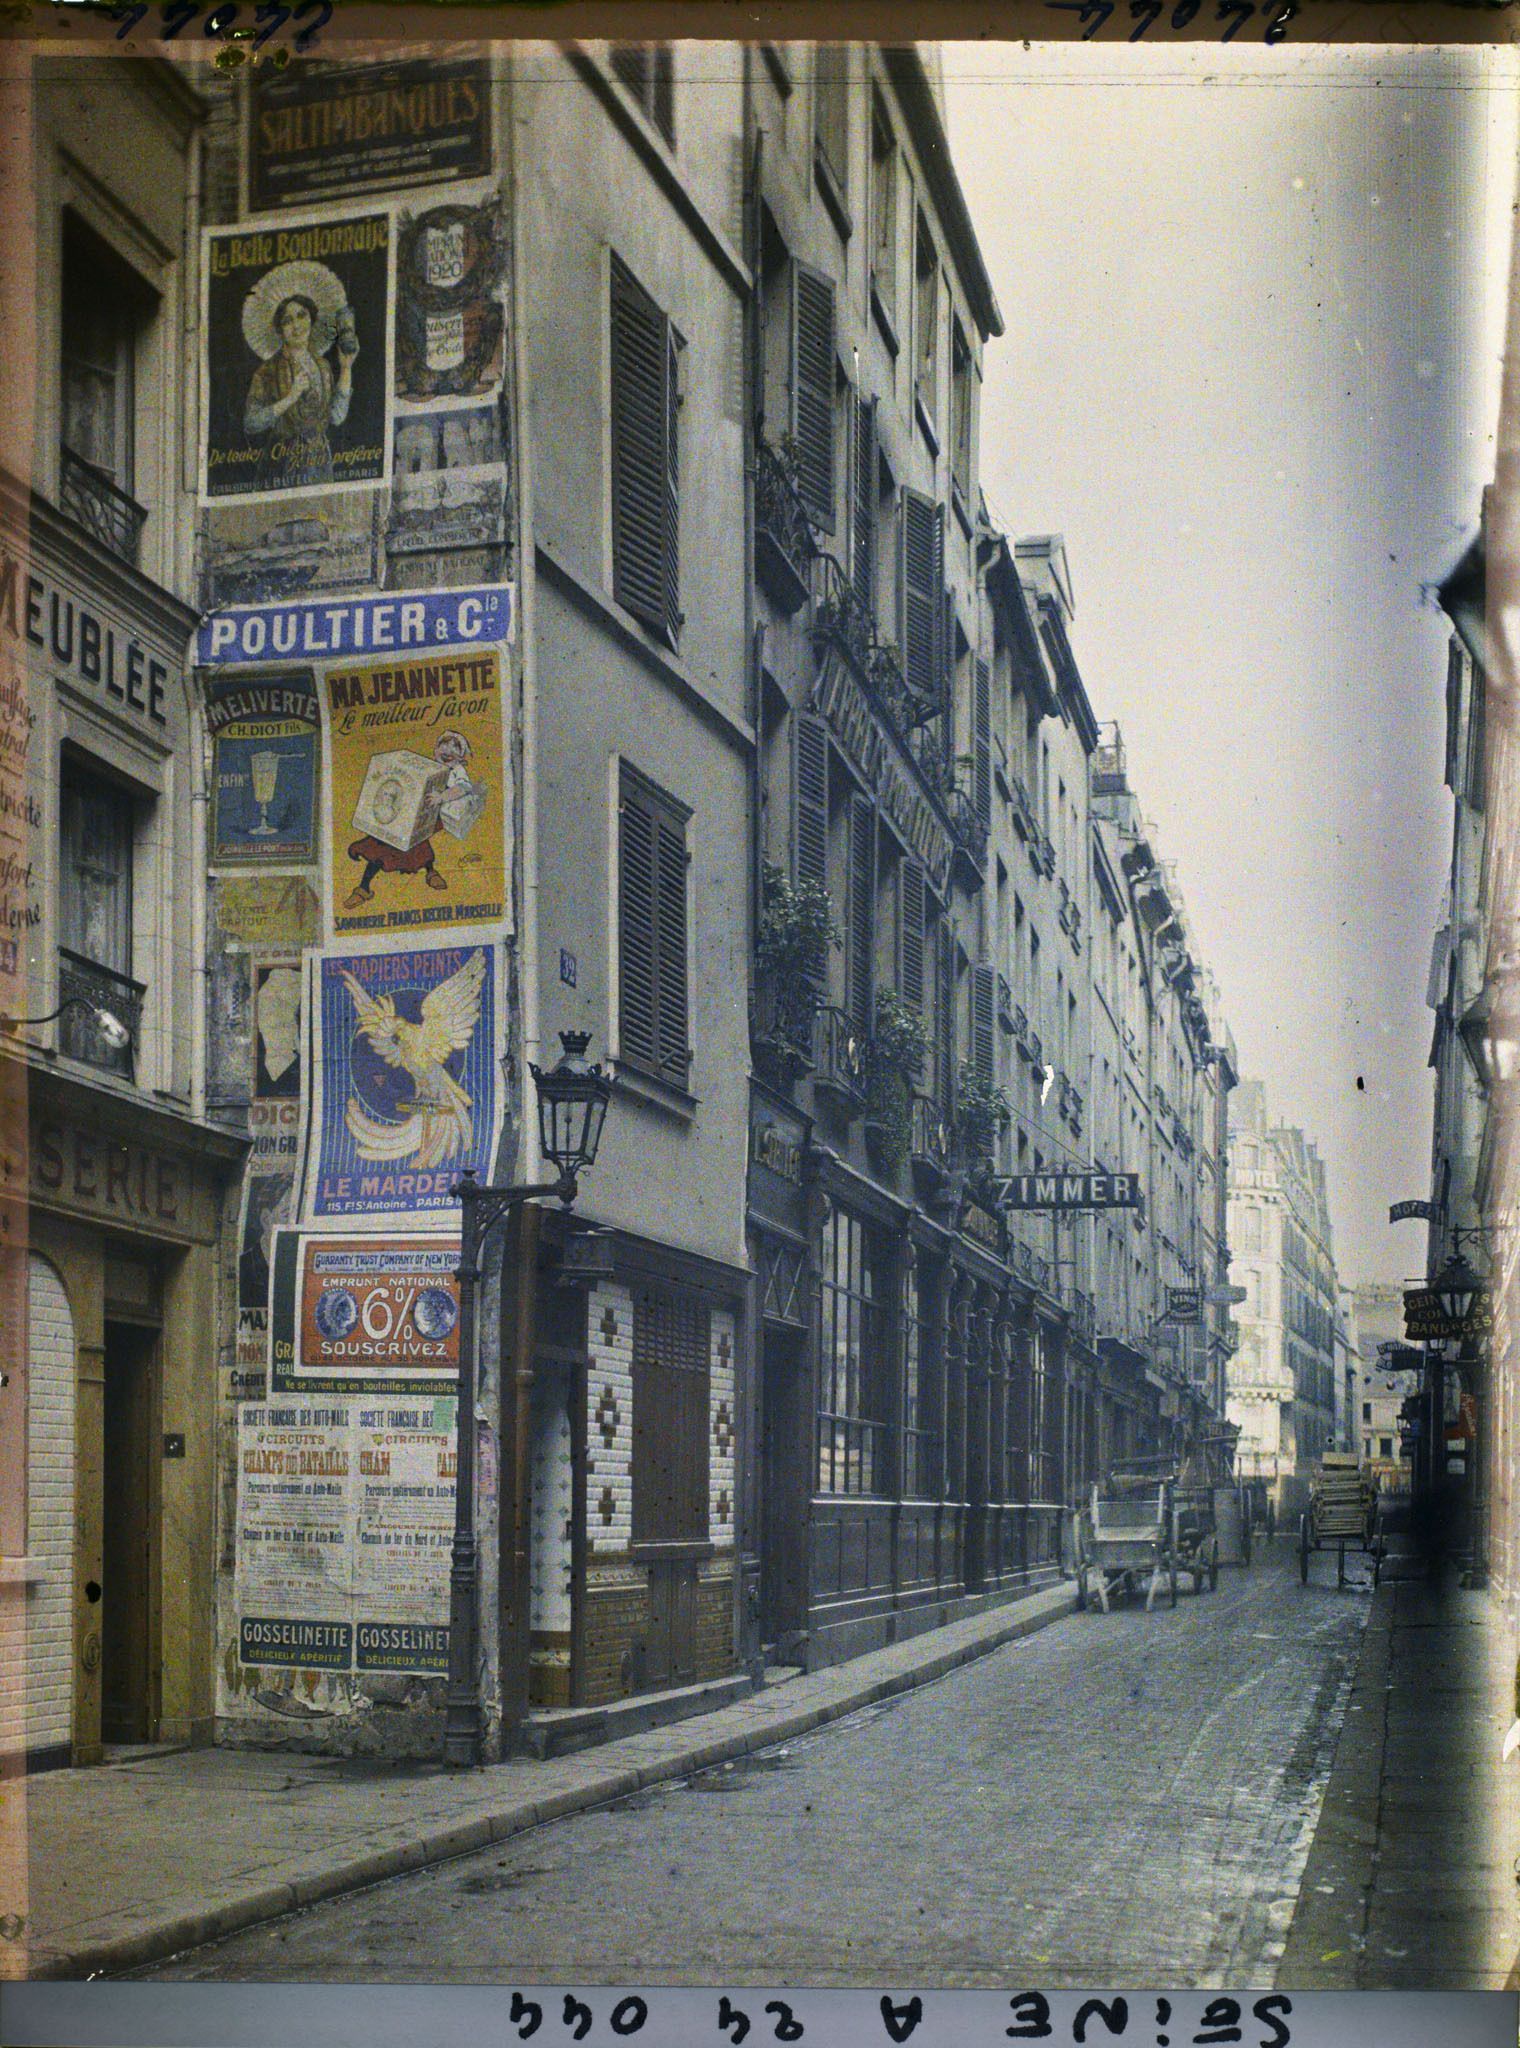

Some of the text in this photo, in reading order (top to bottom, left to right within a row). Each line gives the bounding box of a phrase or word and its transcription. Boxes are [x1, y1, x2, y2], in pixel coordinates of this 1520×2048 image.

[210, 602, 426, 657] POULTIER
[434, 617, 449, 640] &
[329, 658, 495, 710] MA JEANNETTE
[362, 700, 432, 728] meilleur
[432, 695, 490, 727] façon
[350, 953, 410, 982] PAPIERS
[413, 950, 462, 979] PEINTS
[322, 1177, 352, 1198] LE
[999, 1176, 1131, 1204] ZIMMER
[416, 1196, 455, 1208] PARIS
[355, 1254, 378, 1268] TRUST
[379, 1253, 414, 1267] COMPANY
[322, 1276, 450, 1287] EMPRUNT NATIONAL
[362, 1287, 415, 1341] 6%
[320, 1341, 448, 1356] SOUSCRIVEZ
[363, 1380, 406, 1391] bouteilles
[409, 1380, 457, 1392] inviolables
[266, 1434, 325, 1445] CIRCUITS
[360, 1451, 391, 1476] CHAM
[243, 1623, 348, 1648] GOSSELINETTE
[360, 1627, 450, 1651] GOSSELINET
[508, 1992, 651, 2043] 044
[718, 1995, 806, 2043] 24
[880, 1993, 924, 2043] A
